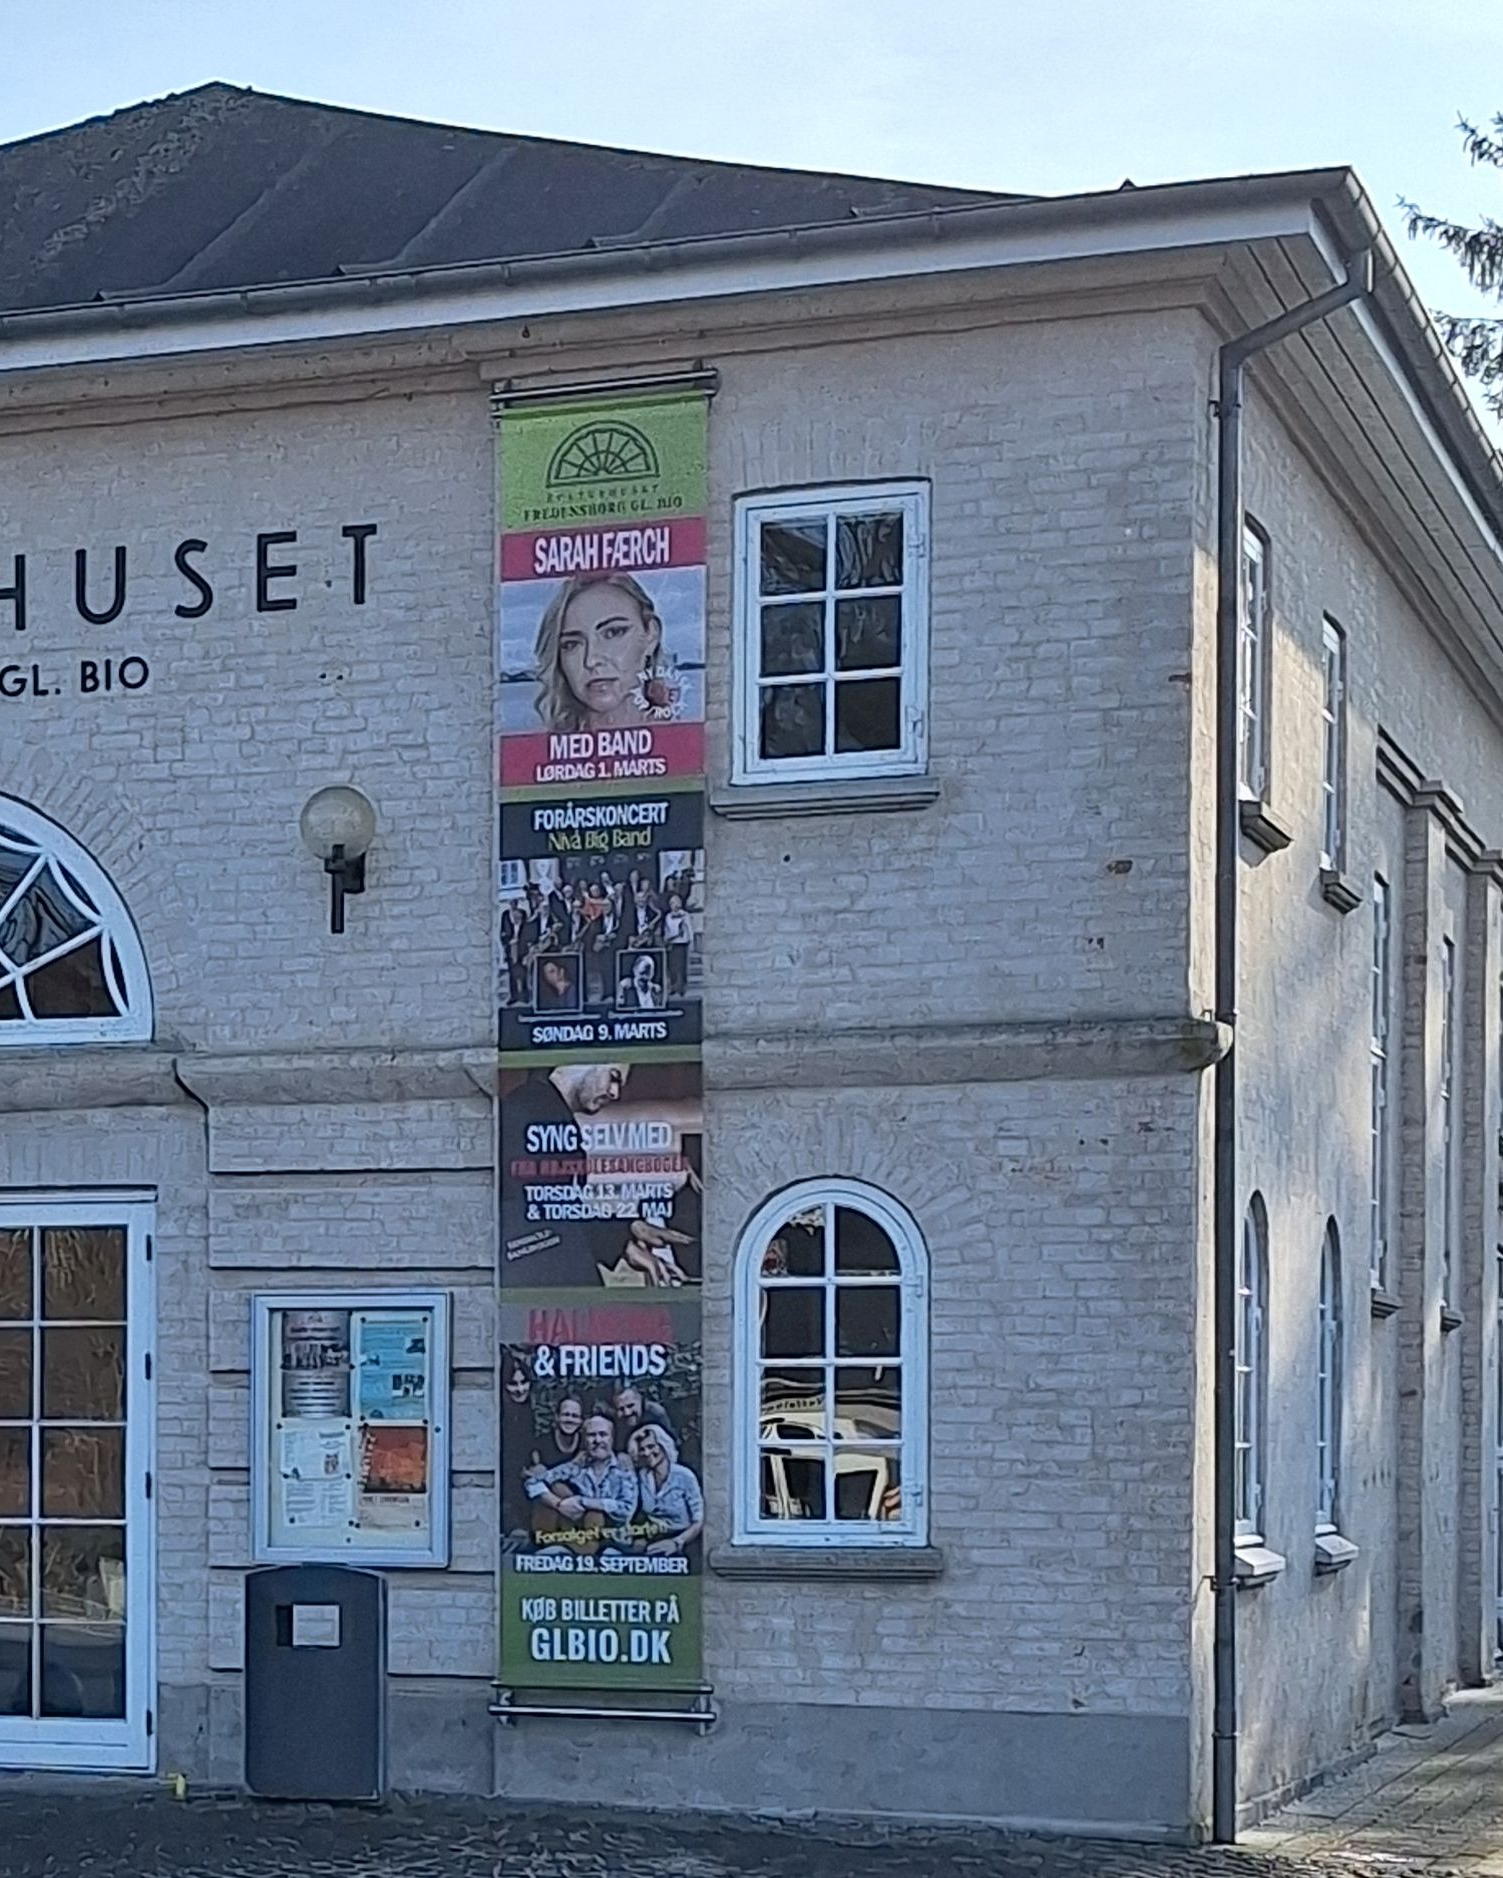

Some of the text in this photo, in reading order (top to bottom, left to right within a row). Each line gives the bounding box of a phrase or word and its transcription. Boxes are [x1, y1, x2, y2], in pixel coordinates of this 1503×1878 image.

[534, 526, 670, 574] SARAH FÆRCH
[80, 656, 149, 693] BIO
[549, 730, 652, 760] MED BAND
[535, 758, 666, 783] LØRDAG 1. MARTS
[533, 801, 669, 831] FORÅRSKONCERT
[612, 825, 652, 848] Band
[532, 1021, 668, 1043] SØNDAG 9. MARTS
[526, 1121, 673, 1153] SYNG SELV MED
[524, 1183, 673, 1202] TORSDAG 13. MARTS
[526, 1203, 541, 1221] &
[543, 1203, 612, 1220] TORSDAG
[642, 1201, 673, 1218] MAJ
[533, 1344, 668, 1377] & FRIENDS
[515, 1554, 689, 1574] FREDAG 19. SEPTEMBER
[520, 1594, 681, 1624] KØB BILLETTER PÅ
[530, 1627, 672, 1664] GLBIO.DK
